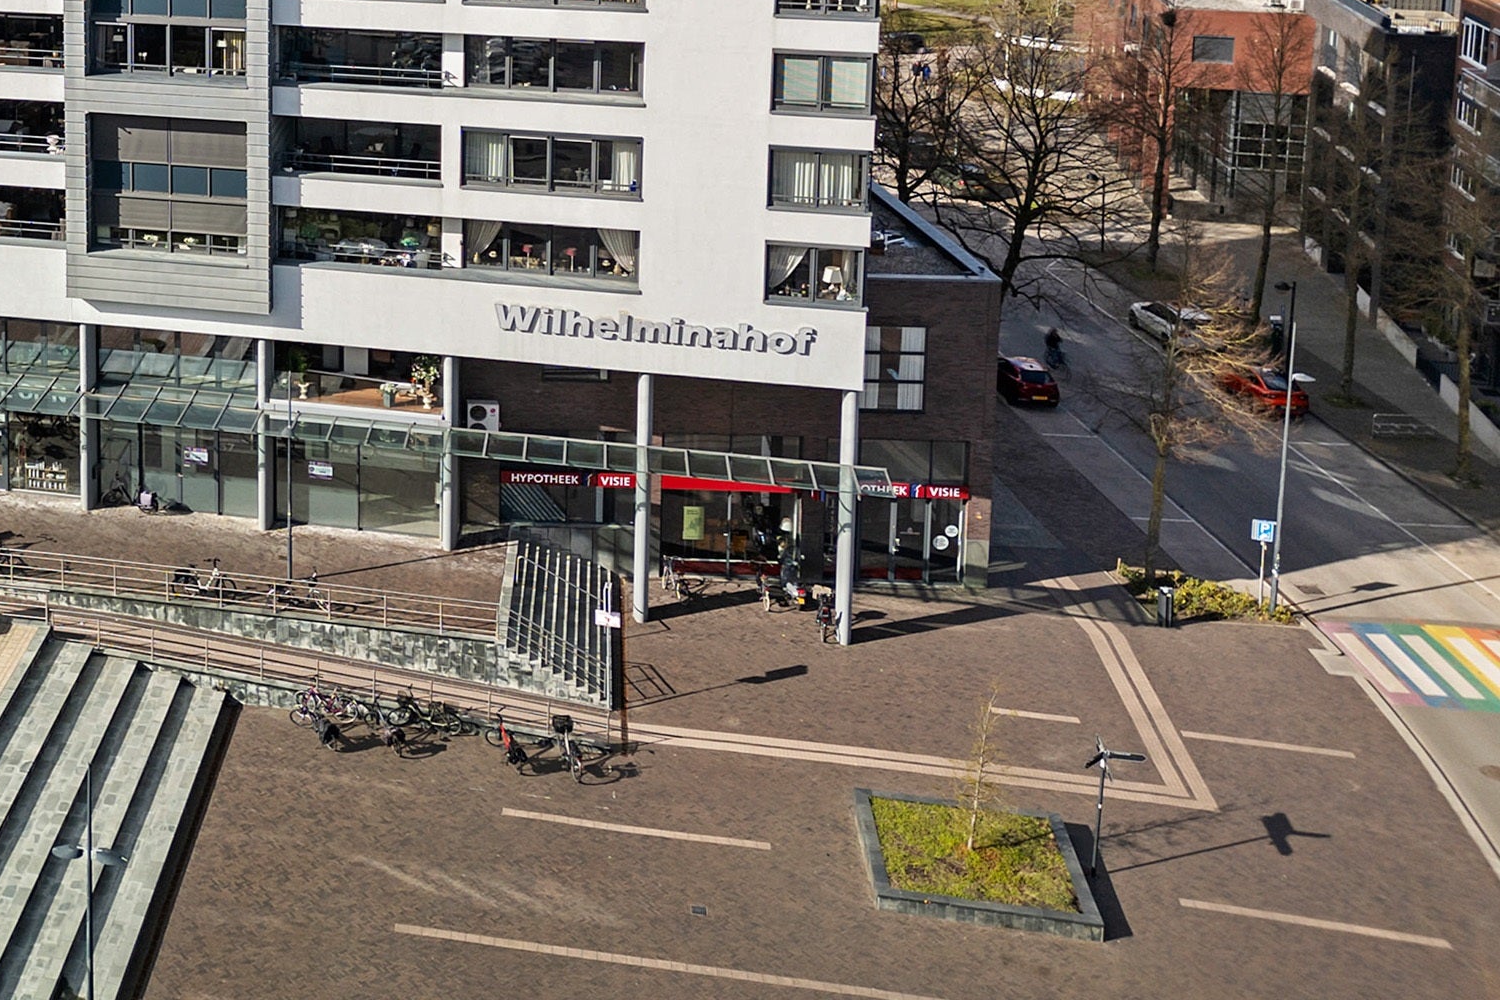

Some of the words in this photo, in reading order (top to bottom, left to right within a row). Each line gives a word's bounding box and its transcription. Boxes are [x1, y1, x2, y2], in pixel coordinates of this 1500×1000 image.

[494, 303, 818, 355] Wilhelminahof
[510, 472, 579, 485] HYPOTHEEK
[600, 476, 631, 487] VISIE
[860, 484, 907, 496] OTHEEK
[929, 487, 960, 497] VISIE
